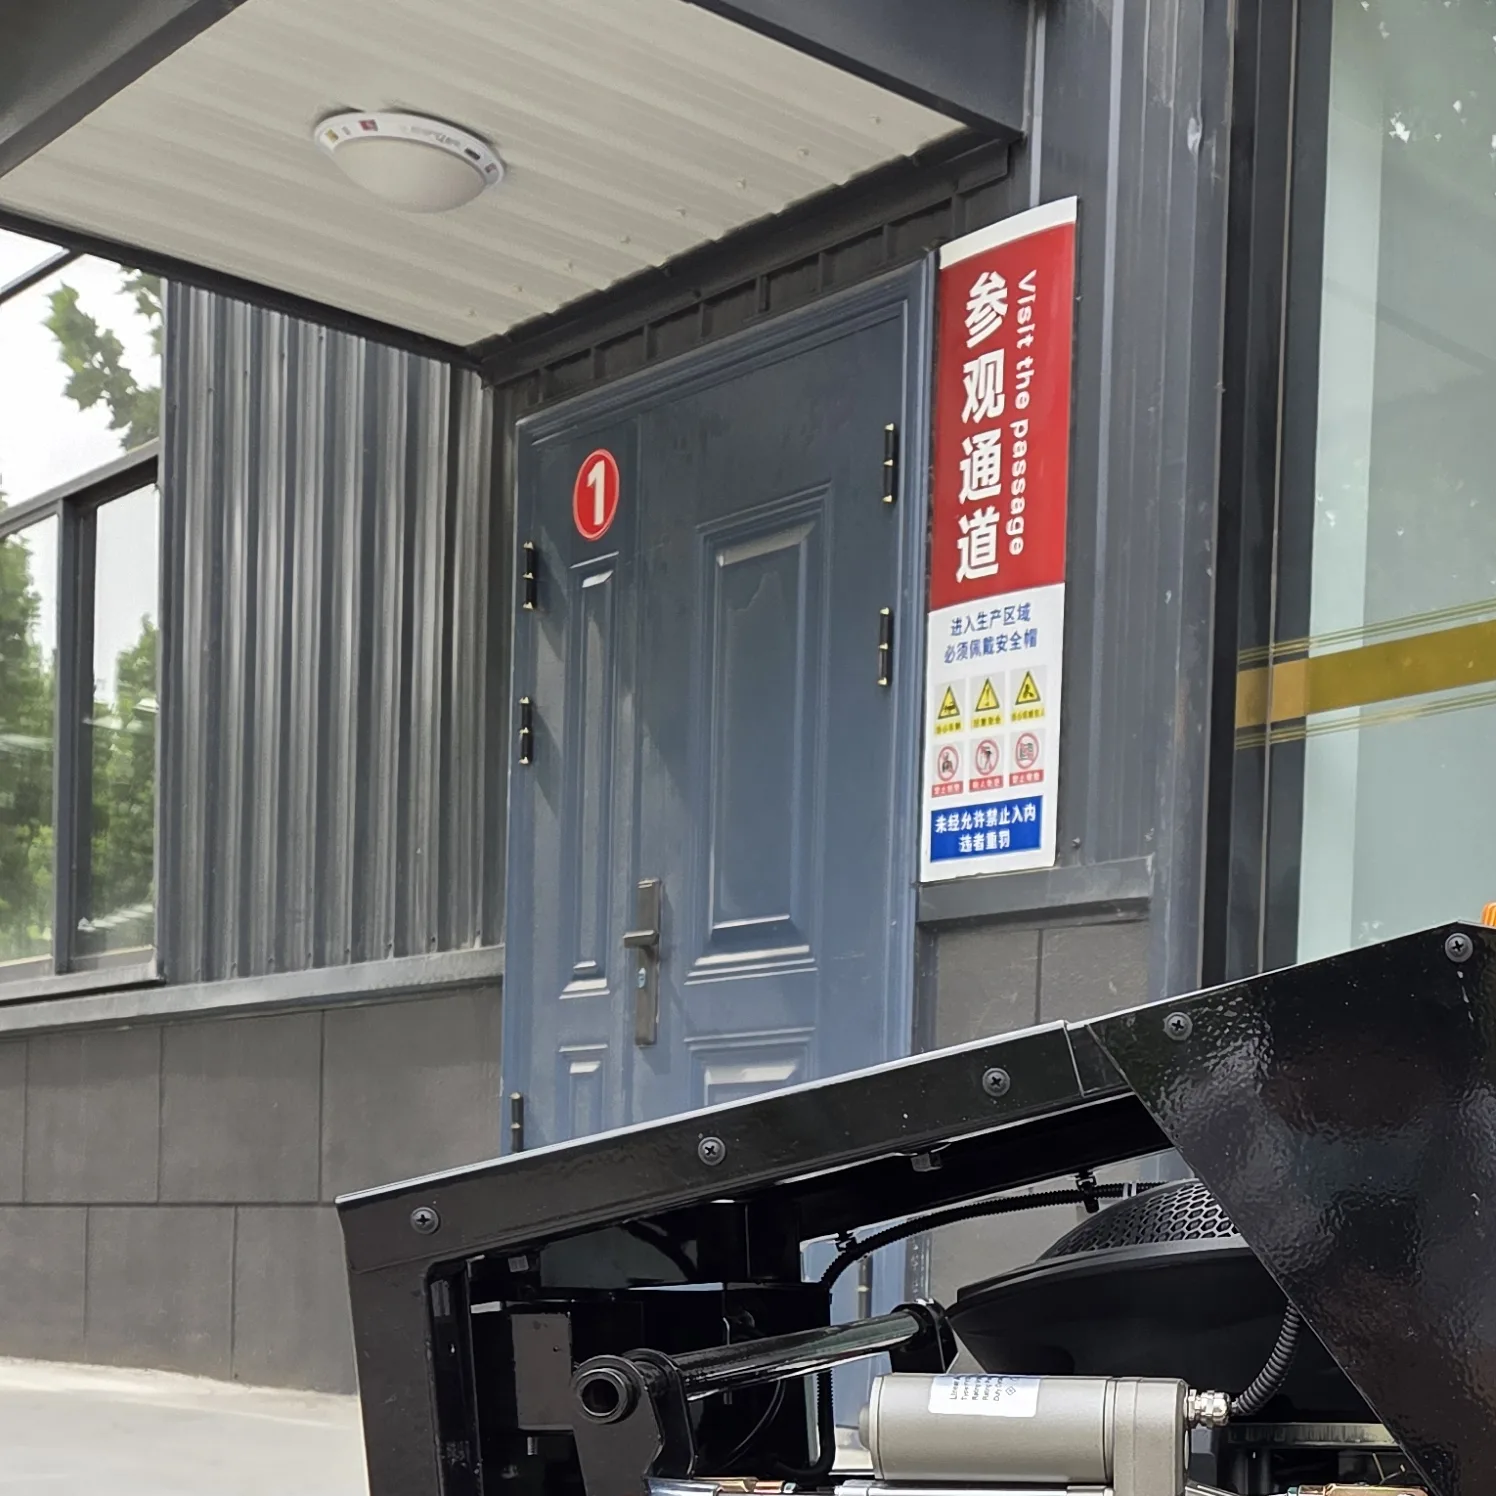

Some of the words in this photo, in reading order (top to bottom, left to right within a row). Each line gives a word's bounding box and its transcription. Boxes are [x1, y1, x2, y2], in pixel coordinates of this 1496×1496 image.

[1016, 269, 1037, 348] Visit
[1015, 357, 1034, 409] the
[956, 271, 1009, 582] 参观通道
[586, 459, 605, 526] 1
[1005, 418, 1029, 555] passage
[944, 628, 1037, 663] 必须佩戴安全帽
[951, 602, 1031, 636] 进入生产区域
[935, 802, 1036, 833] 未经允许禁止入内
